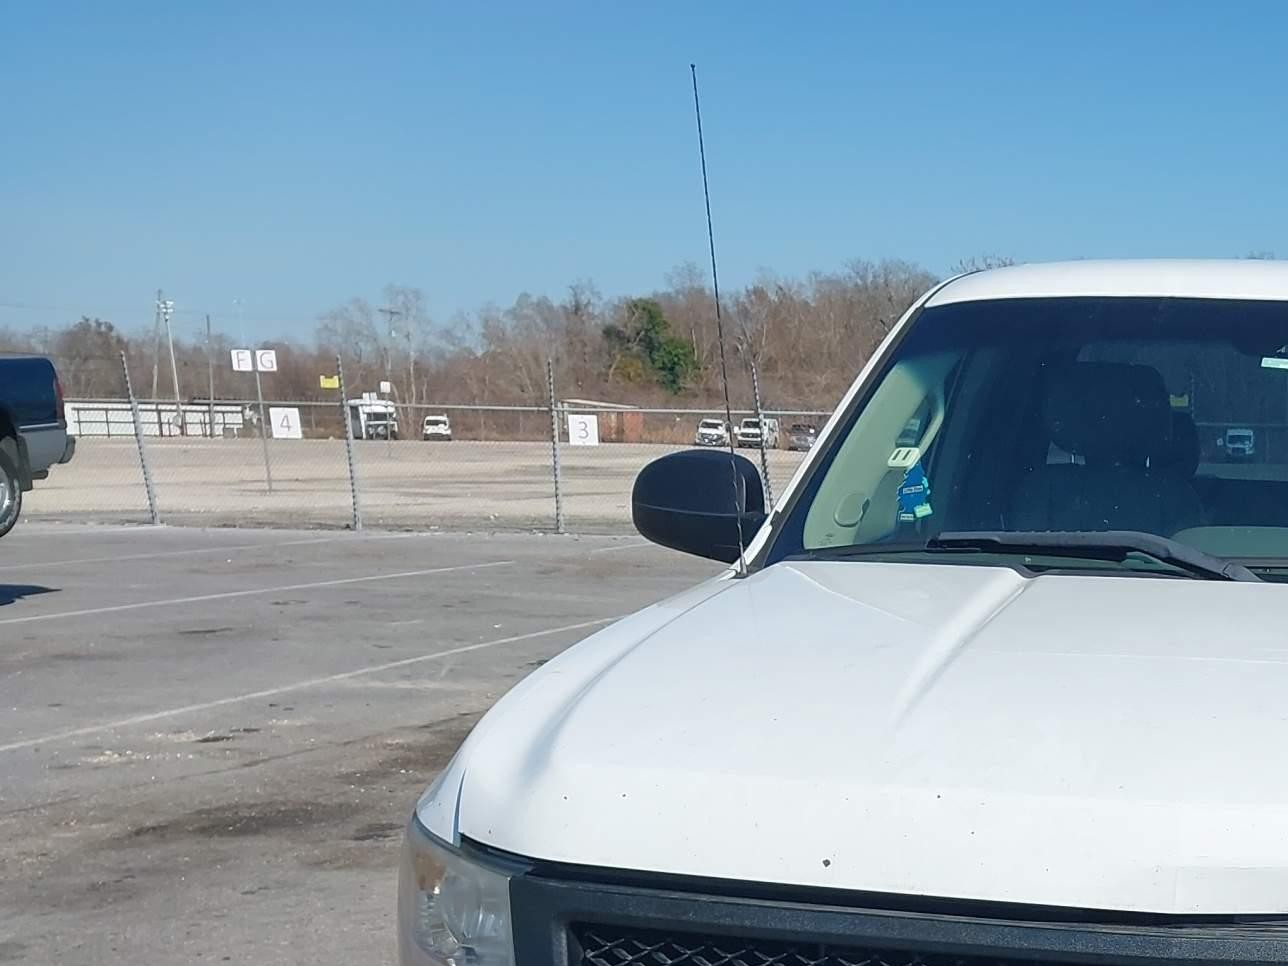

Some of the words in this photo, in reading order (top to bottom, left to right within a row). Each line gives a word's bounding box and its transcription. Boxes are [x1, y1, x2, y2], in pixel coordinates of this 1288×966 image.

[236, 351, 247, 369] F
[259, 351, 275, 370] G
[280, 414, 292, 432] 4
[576, 421, 589, 439] 3
